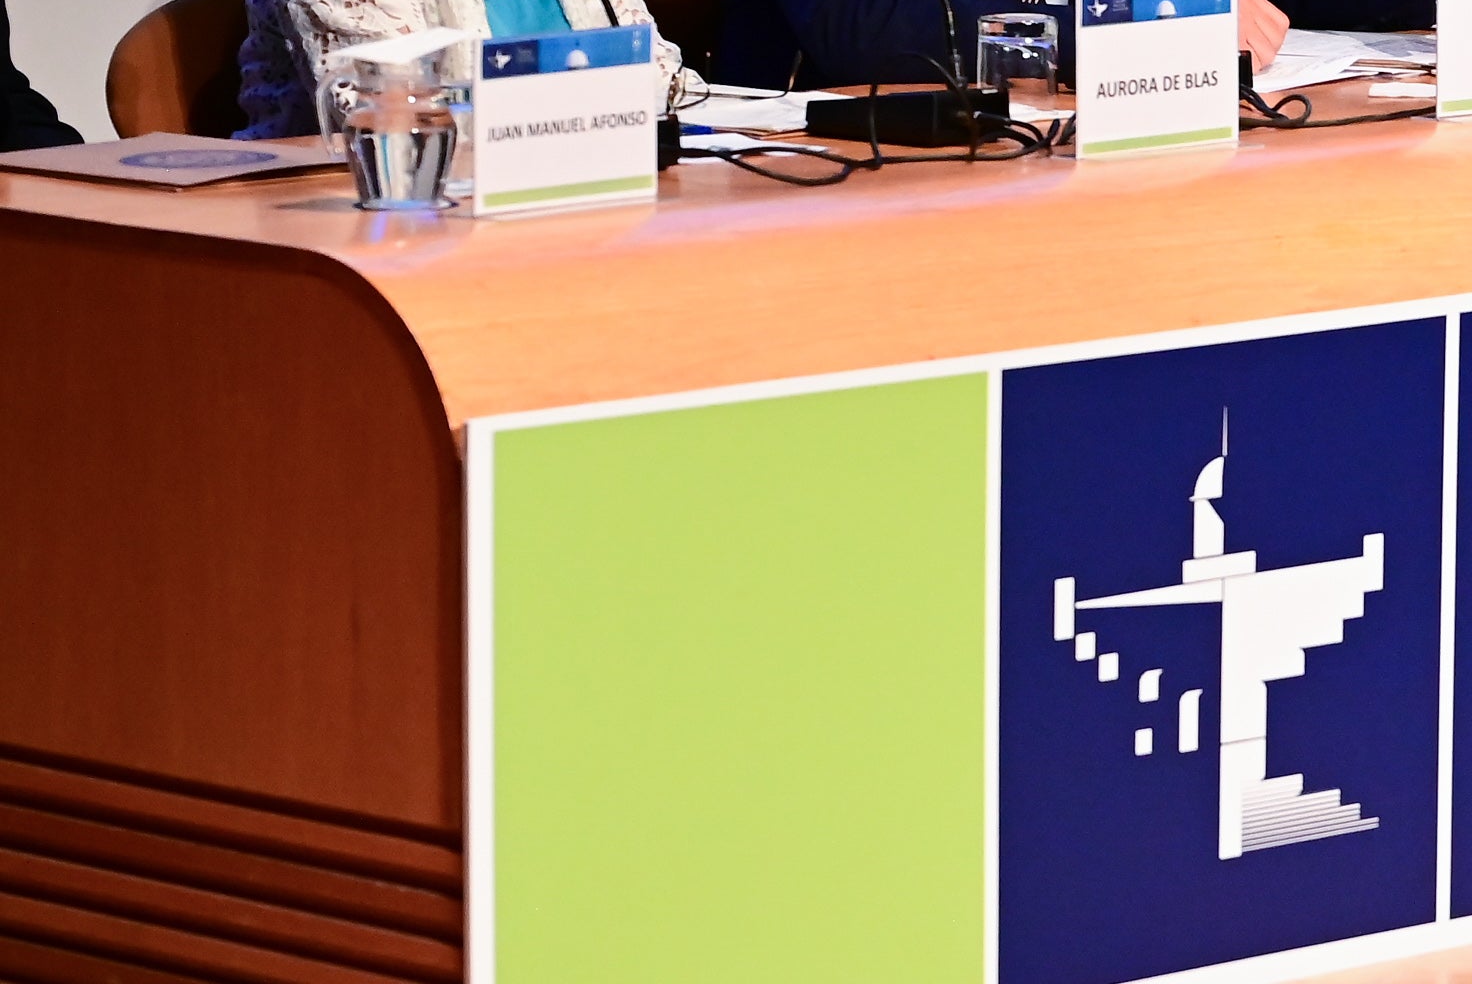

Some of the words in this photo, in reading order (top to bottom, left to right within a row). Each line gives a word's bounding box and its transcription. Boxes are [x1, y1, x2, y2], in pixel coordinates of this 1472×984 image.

[1096, 77, 1159, 99] AURORA
[1162, 74, 1181, 92] DE
[1184, 70, 1218, 89] BLAS
[488, 125, 522, 142] JUAN
[526, 116, 586, 137] MANUEL
[590, 110, 648, 130] AFONSO
